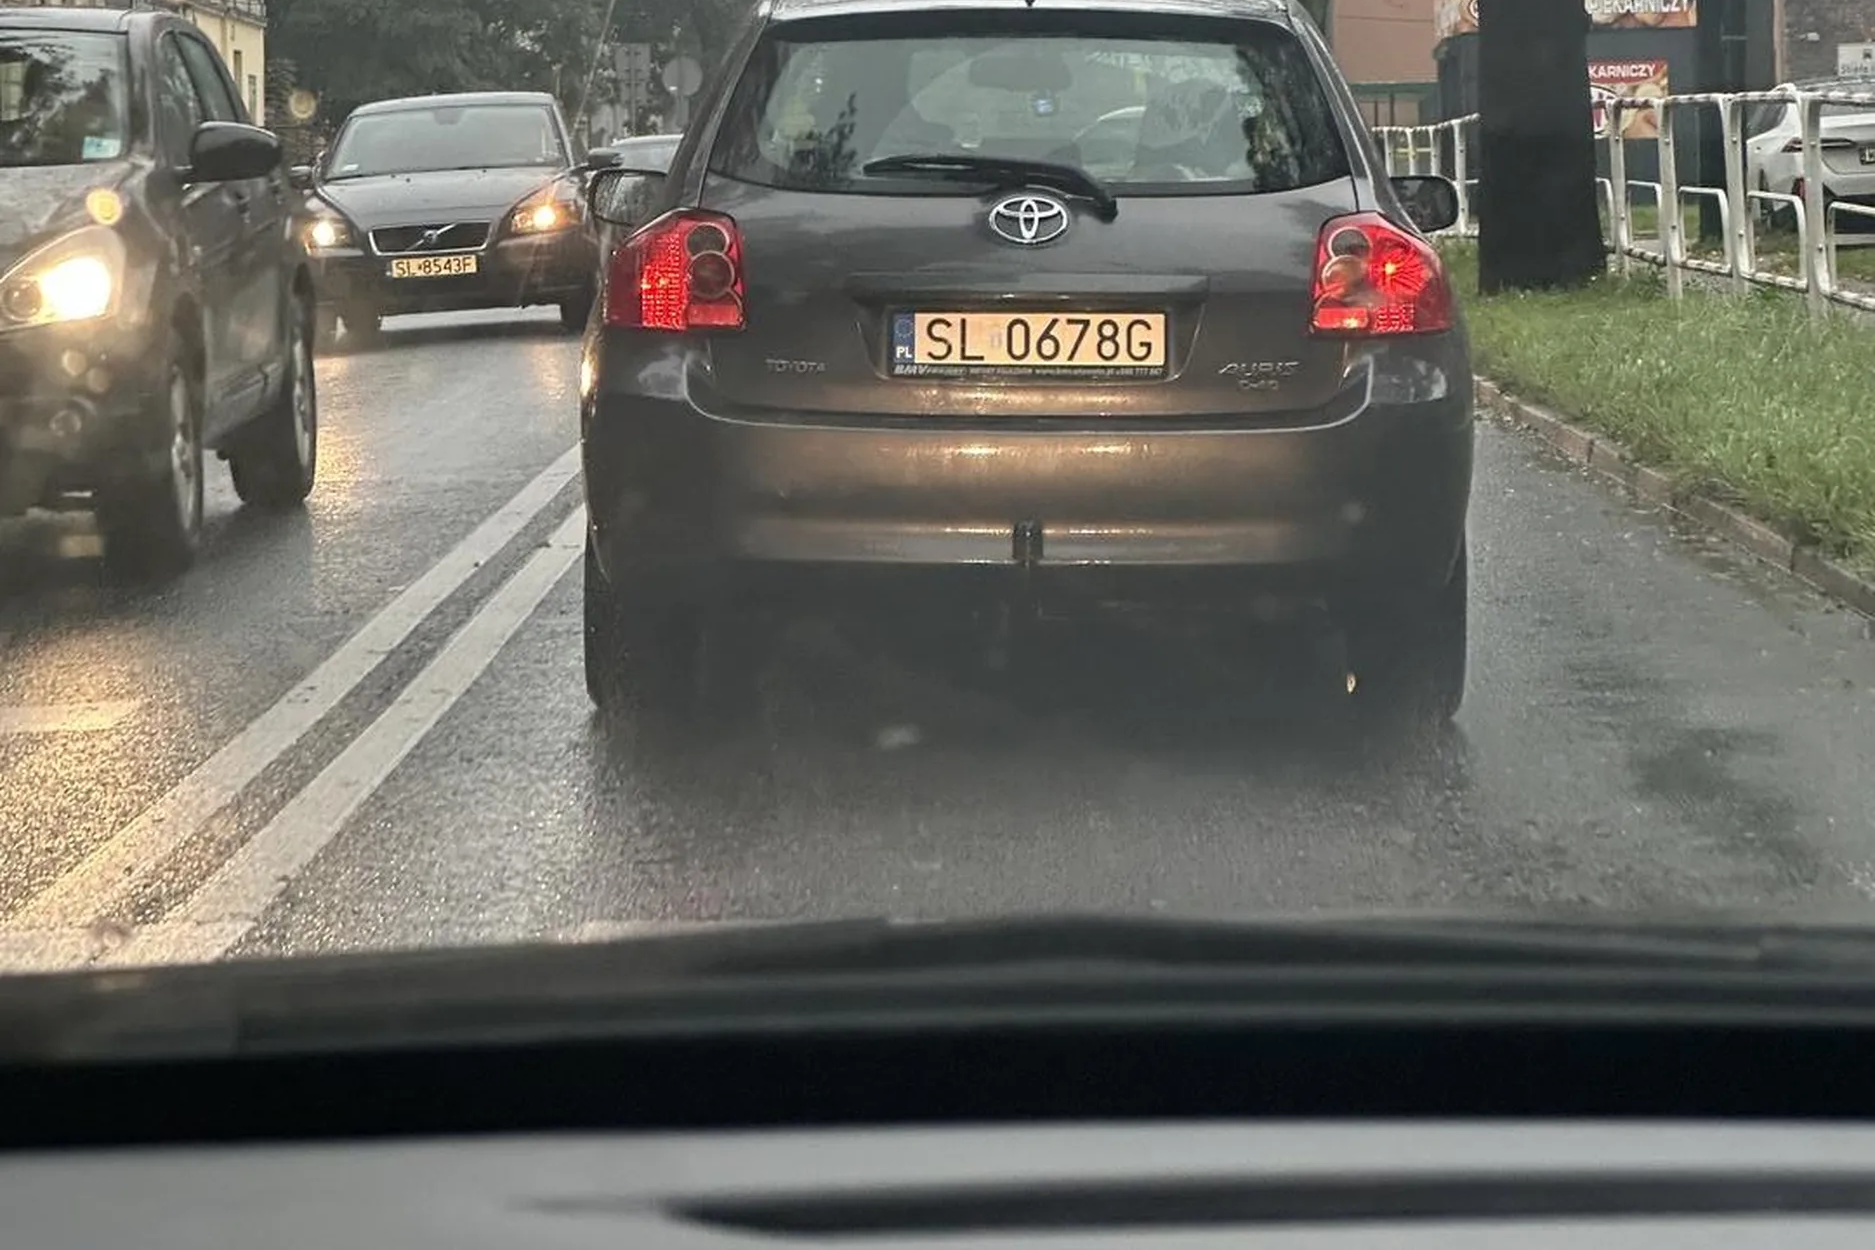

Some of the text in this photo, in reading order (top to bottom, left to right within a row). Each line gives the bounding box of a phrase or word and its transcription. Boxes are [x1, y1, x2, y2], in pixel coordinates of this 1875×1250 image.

[896, 346, 913, 359] PL
[926, 317, 1153, 361] SL 0678G
